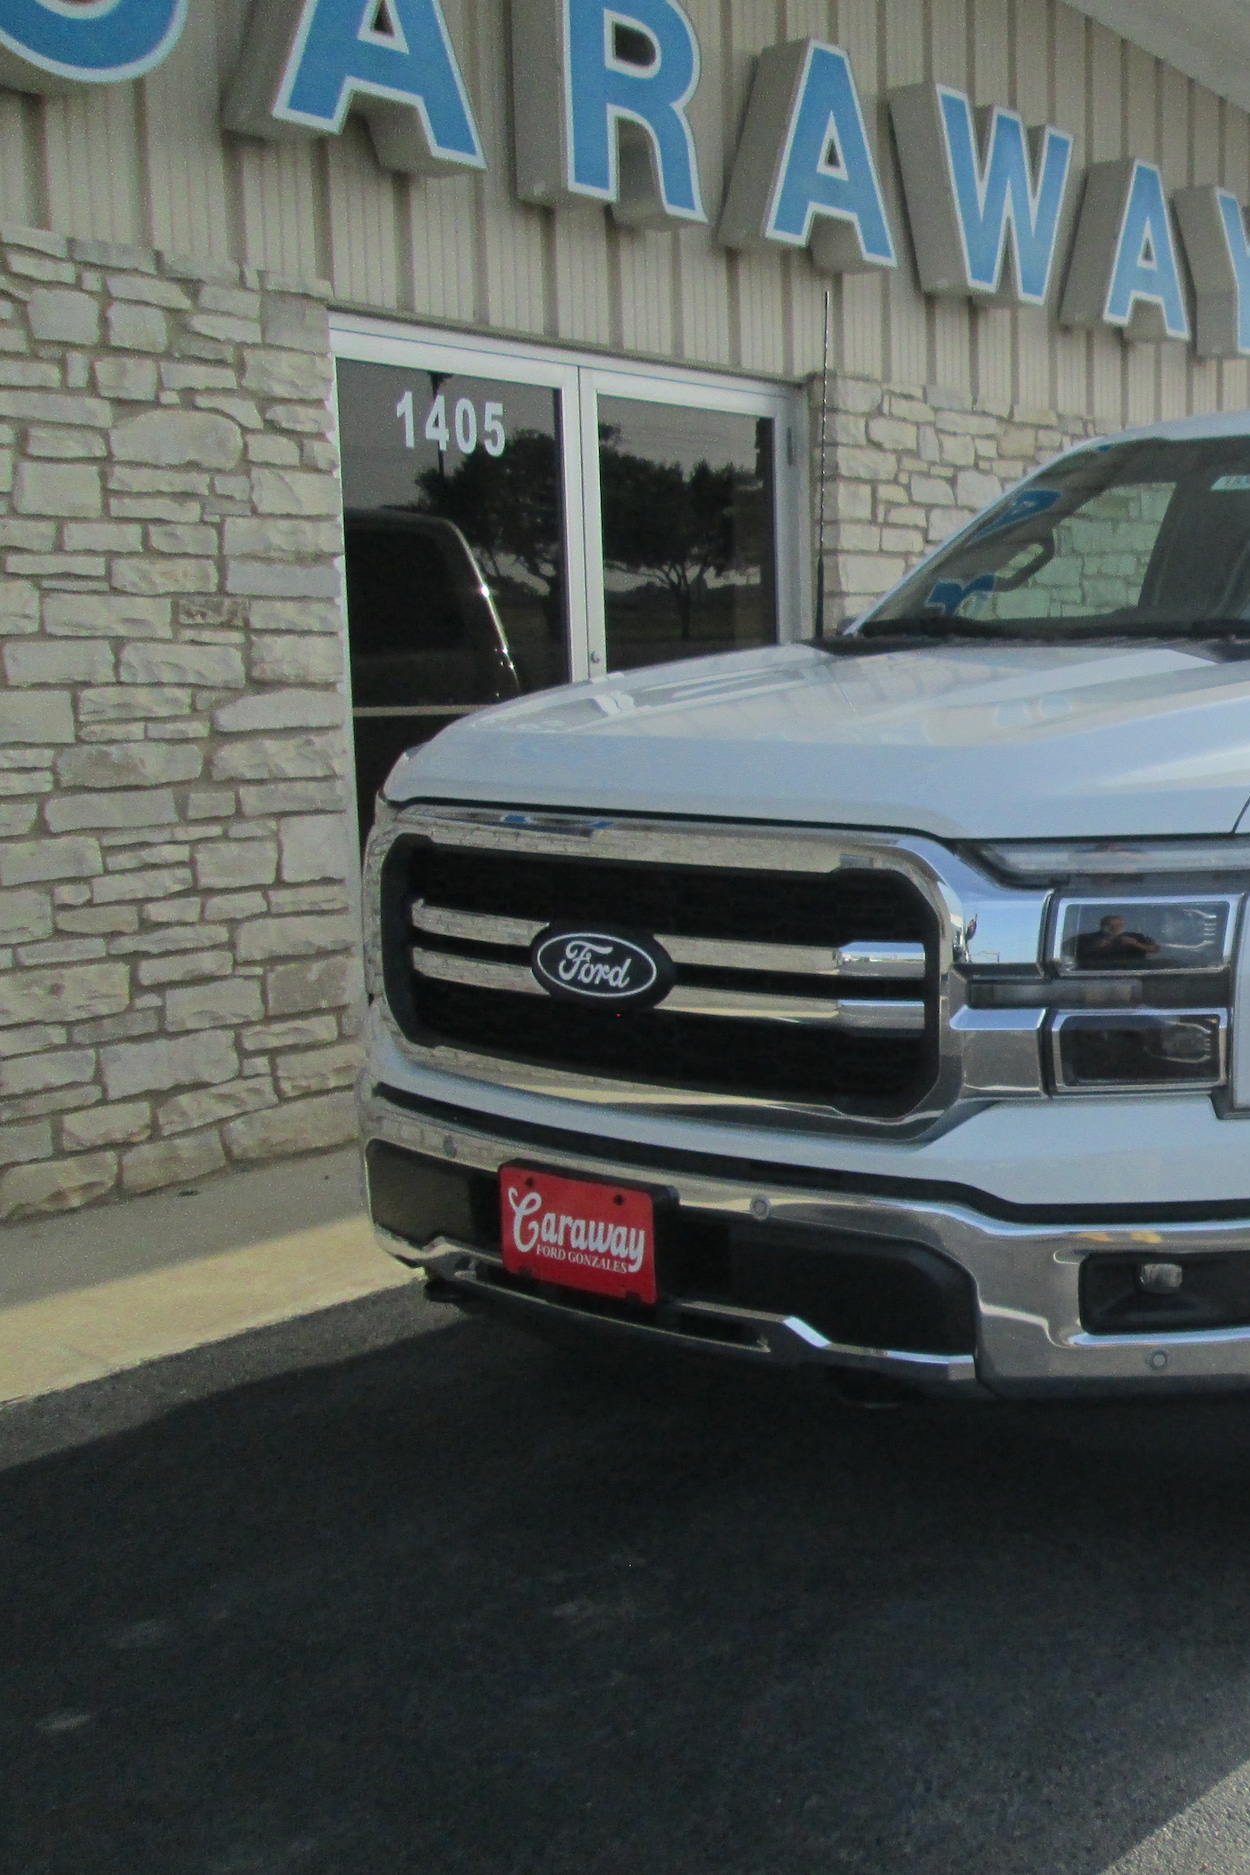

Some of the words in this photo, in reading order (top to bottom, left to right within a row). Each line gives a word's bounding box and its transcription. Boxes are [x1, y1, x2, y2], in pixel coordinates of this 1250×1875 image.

[396, 391, 506, 457] 1405
[558, 940, 632, 988] Ford
[508, 1186, 646, 1273] Caraway
[536, 1244, 567, 1261] FORD
[568, 1252, 628, 1274] GONZALES
